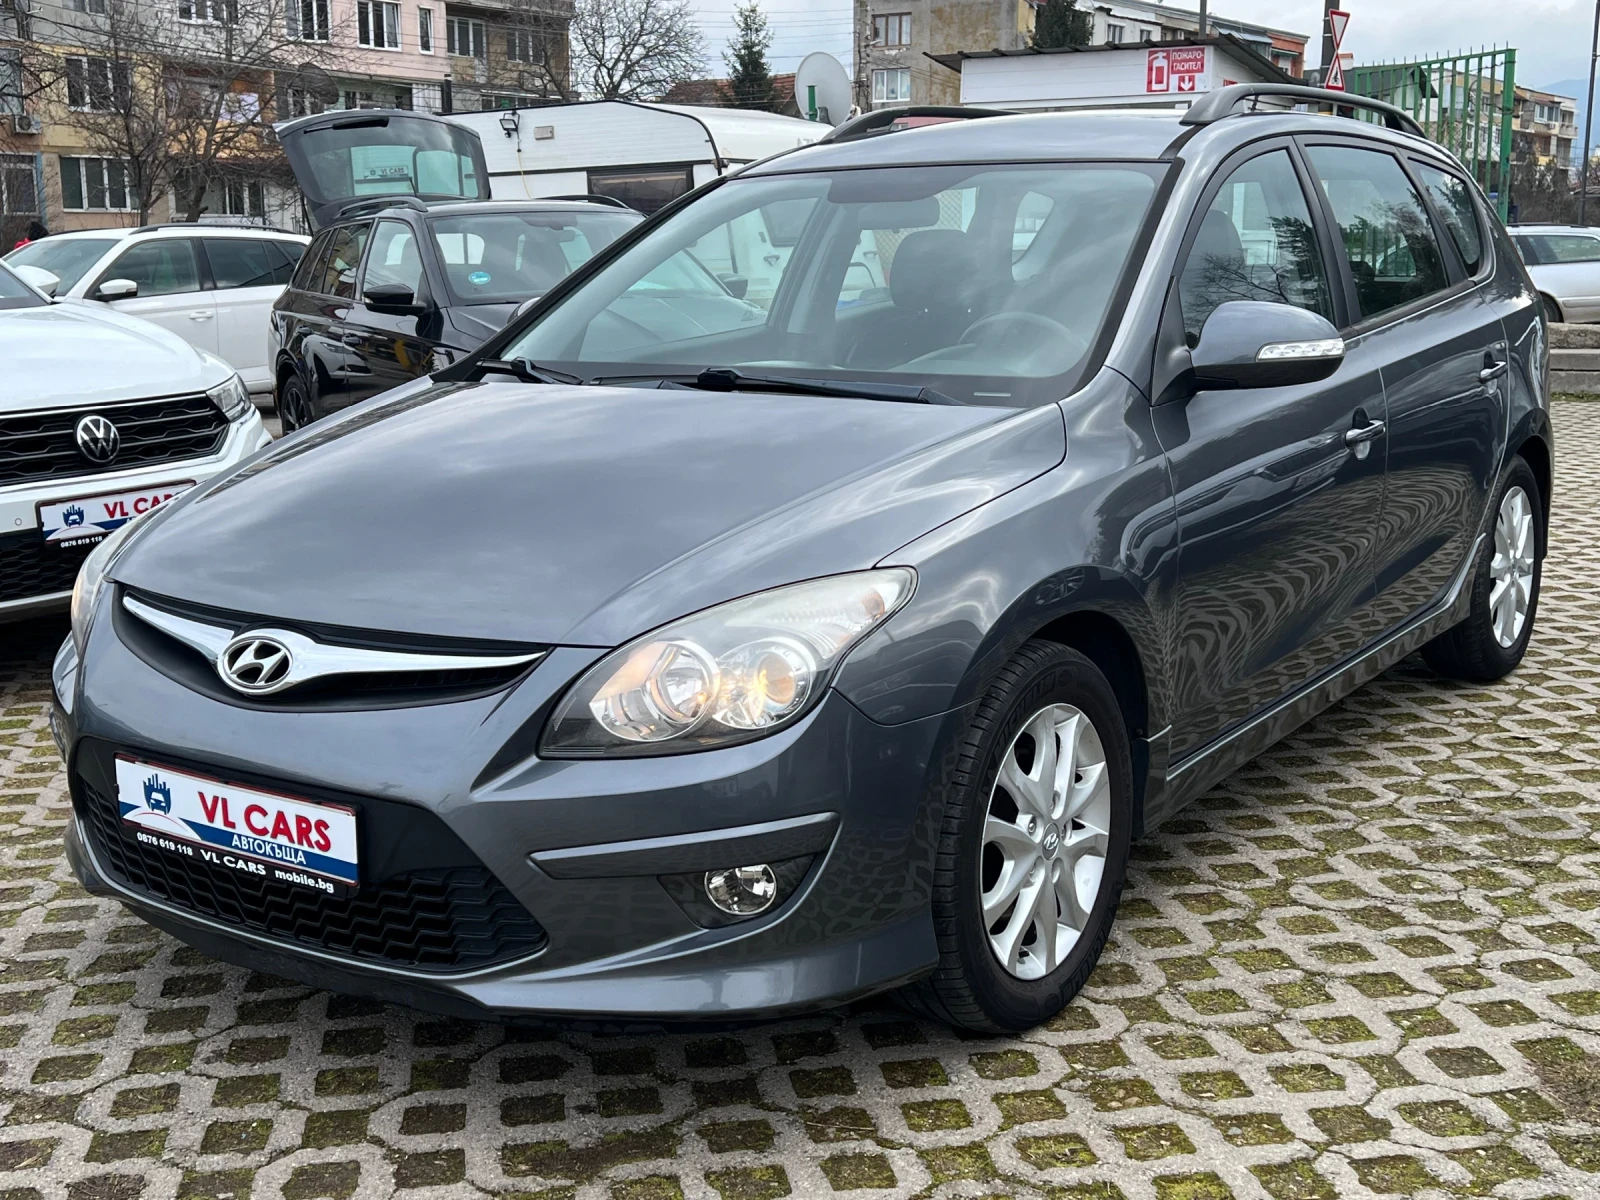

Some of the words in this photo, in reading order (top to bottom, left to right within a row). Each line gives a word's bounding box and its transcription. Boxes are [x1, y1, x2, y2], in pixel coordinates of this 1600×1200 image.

[1172, 50, 1204, 60] ПОЖАРО-
[1173, 61, 1202, 71] ГАСИТЕЛ
[103, 501, 129, 518] VL
[60, 539, 77, 548] 0876
[992, 670, 1056, 765] MICHELIN
[198, 791, 236, 829] VL
[244, 804, 331, 852] CARS
[232, 834, 307, 865] АВТОКЪЩА
[136, 832, 158, 846] 0876
[159, 839, 175, 851] 619
[177, 844, 193, 856] 118
[200, 849, 220, 864] VL
[223, 856, 266, 875] CARS
[275, 869, 334, 893] mobile.bg
